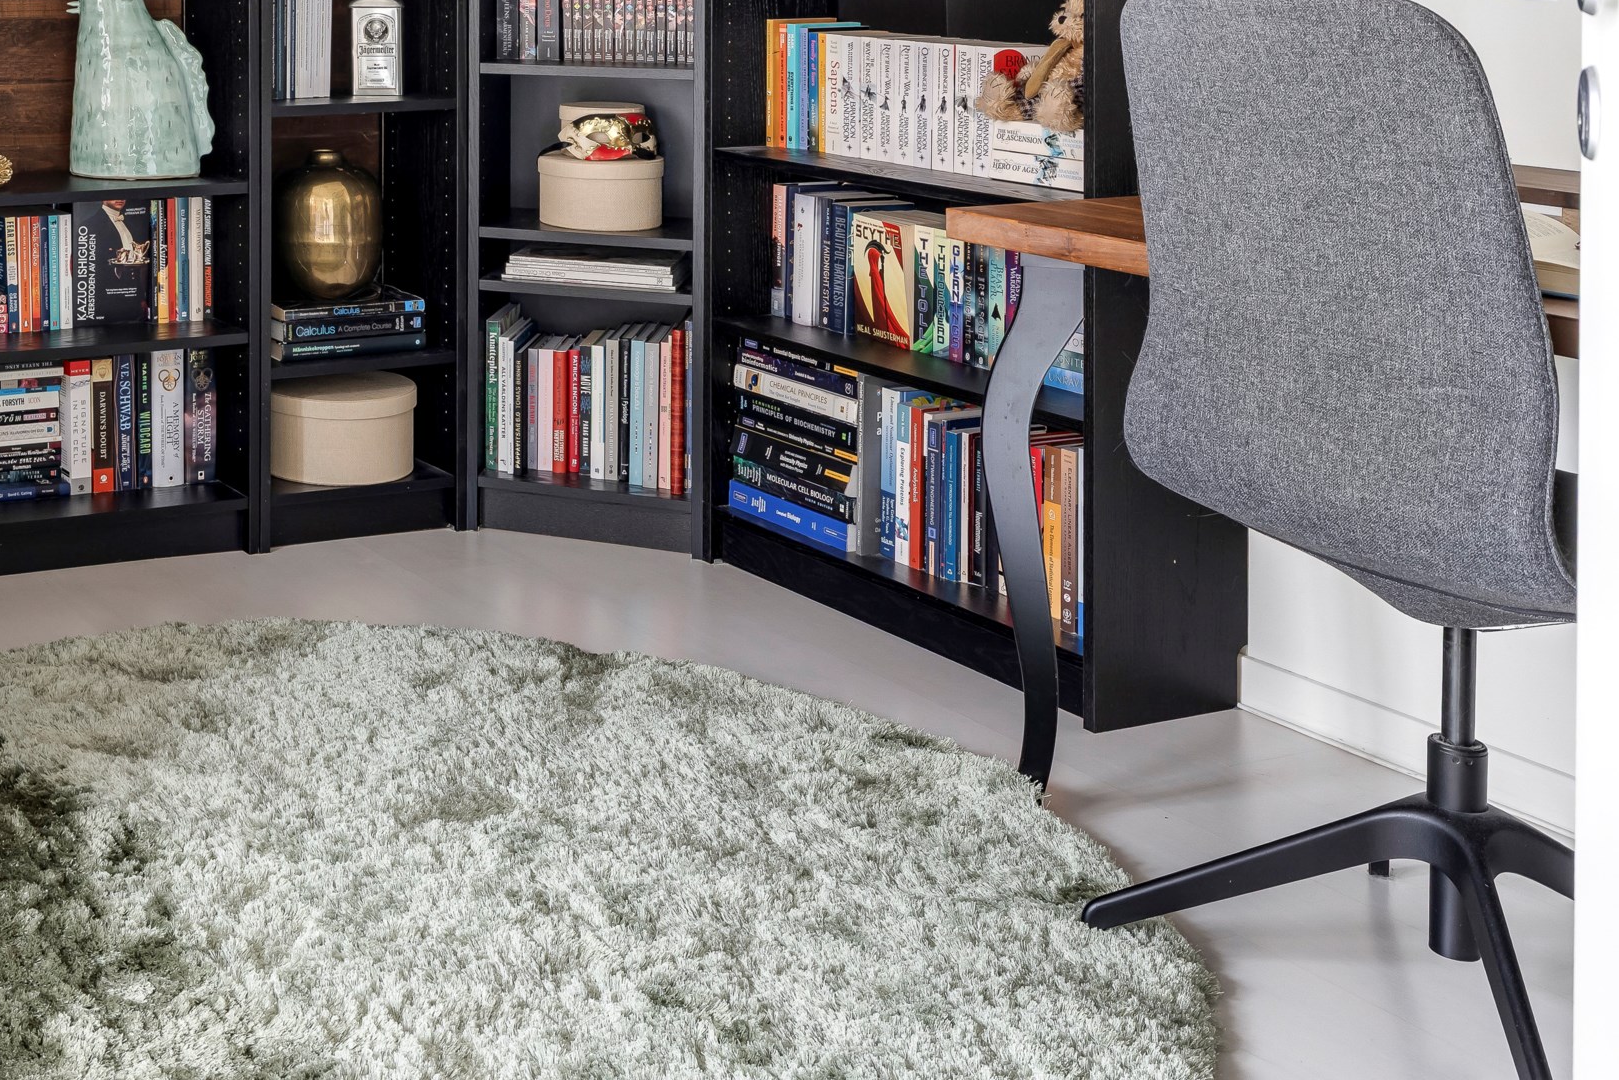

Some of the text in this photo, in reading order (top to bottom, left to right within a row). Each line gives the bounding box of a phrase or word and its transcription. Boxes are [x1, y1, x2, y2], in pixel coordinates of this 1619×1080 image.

[358, 45, 395, 56] Jägermeister
[828, 60, 840, 115] Sapiens
[992, 162, 1011, 170] HERO
[1021, 166, 1039, 174] AGES
[856, 224, 901, 249] SCYTHE
[77, 226, 88, 321] KAZUO ISHIGURO
[89, 262, 95, 270] AV
[834, 217, 846, 307] BEAUTIFUL DARKNESS
[86, 273, 95, 319] ÅTERSTODEN
[918, 238, 928, 340] THE TOLL
[333, 306, 360, 316] Calculus
[295, 325, 336, 338] Calculus
[344, 324, 370, 333] Complete
[372, 322, 392, 330] Course
[856, 323, 908, 345] NEAL SHUSTERMAN
[741, 356, 778, 373] bioinformatics
[120, 363, 130, 430] V.E. SCHWAB
[580, 375, 591, 394] MOVE
[770, 380, 828, 405] CHEMICAL PRINCIPLES
[2, 398, 24, 407] FORSYTH
[99, 391, 107, 430] DARWIN'S
[142, 393, 147, 403] LU
[139, 411, 151, 454] WILDCARD
[197, 410, 205, 444] STORM
[752, 404, 836, 438] PRINCIPLES OF BIOCHEMISTRY
[766, 473, 834, 504] MOLECULAR CELL BIOLOGY
